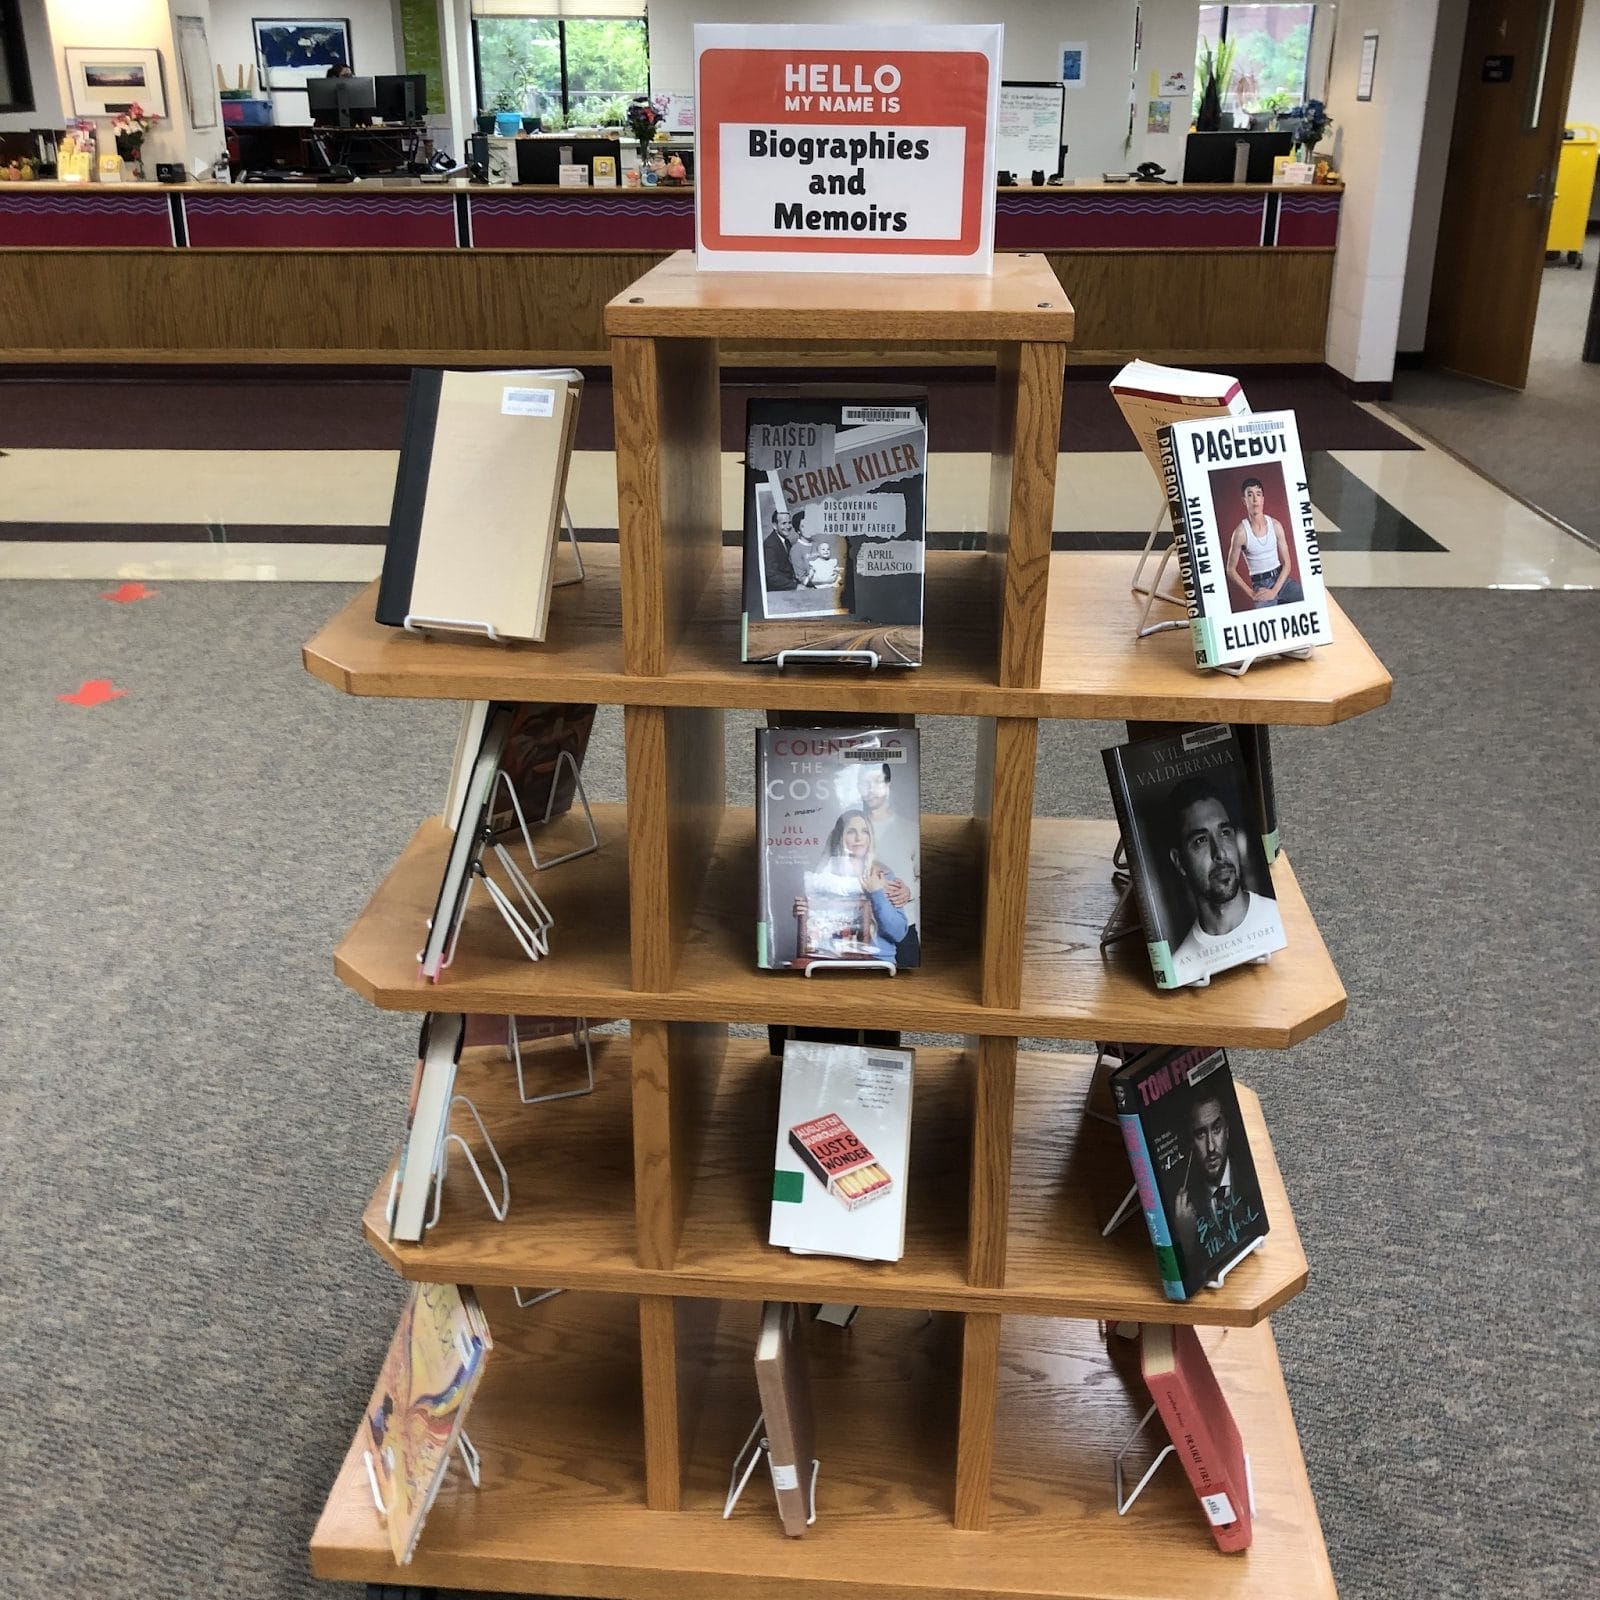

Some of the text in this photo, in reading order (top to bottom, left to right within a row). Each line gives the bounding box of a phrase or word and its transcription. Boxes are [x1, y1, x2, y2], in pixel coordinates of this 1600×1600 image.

[785, 63, 902, 94] HELLO
[785, 96, 901, 113] MY NAME IS
[749, 130, 930, 165] Biographies
[808, 168, 866, 195] and
[774, 202, 908, 232] Memoirs
[762, 427, 817, 447] RAISED
[774, 449, 807, 470] BY A
[1158, 436, 1181, 503] PAGEBOY
[782, 443, 920, 505] SERIAL KILLER
[823, 501, 878, 511] DISCOVERING
[823, 512, 866, 521] THE TRUTH
[823, 523, 897, 533] ABOUT MY FATHER
[1296, 482, 1322, 576] A MEMOIR
[867, 549, 894, 560] APRIL
[1188, 496, 1216, 594] A MEMOIR
[867, 561, 913, 572] BALASCIO
[1175, 533, 1195, 586] ELLIOT
[1184, 591, 1200, 618] PAG
[1223, 619, 1278, 650] ELLIOT
[1280, 611, 1321, 640] PAGE
[774, 739, 902, 757] COUN
[790, 762, 823, 774] THE
[1136, 749, 1235, 786] VALDERRAMA
[768, 778, 831, 801] COS
[768, 837, 819, 846] DUGGAR
[782, 826, 804, 834] JILL
[1197, 937, 1243, 959] AMERICAN
[1246, 925, 1275, 942] STORY
[1137, 1065, 1173, 1107] TOM
[811, 1134, 859, 1159] LUST &
[820, 1147, 874, 1170] WONDER
